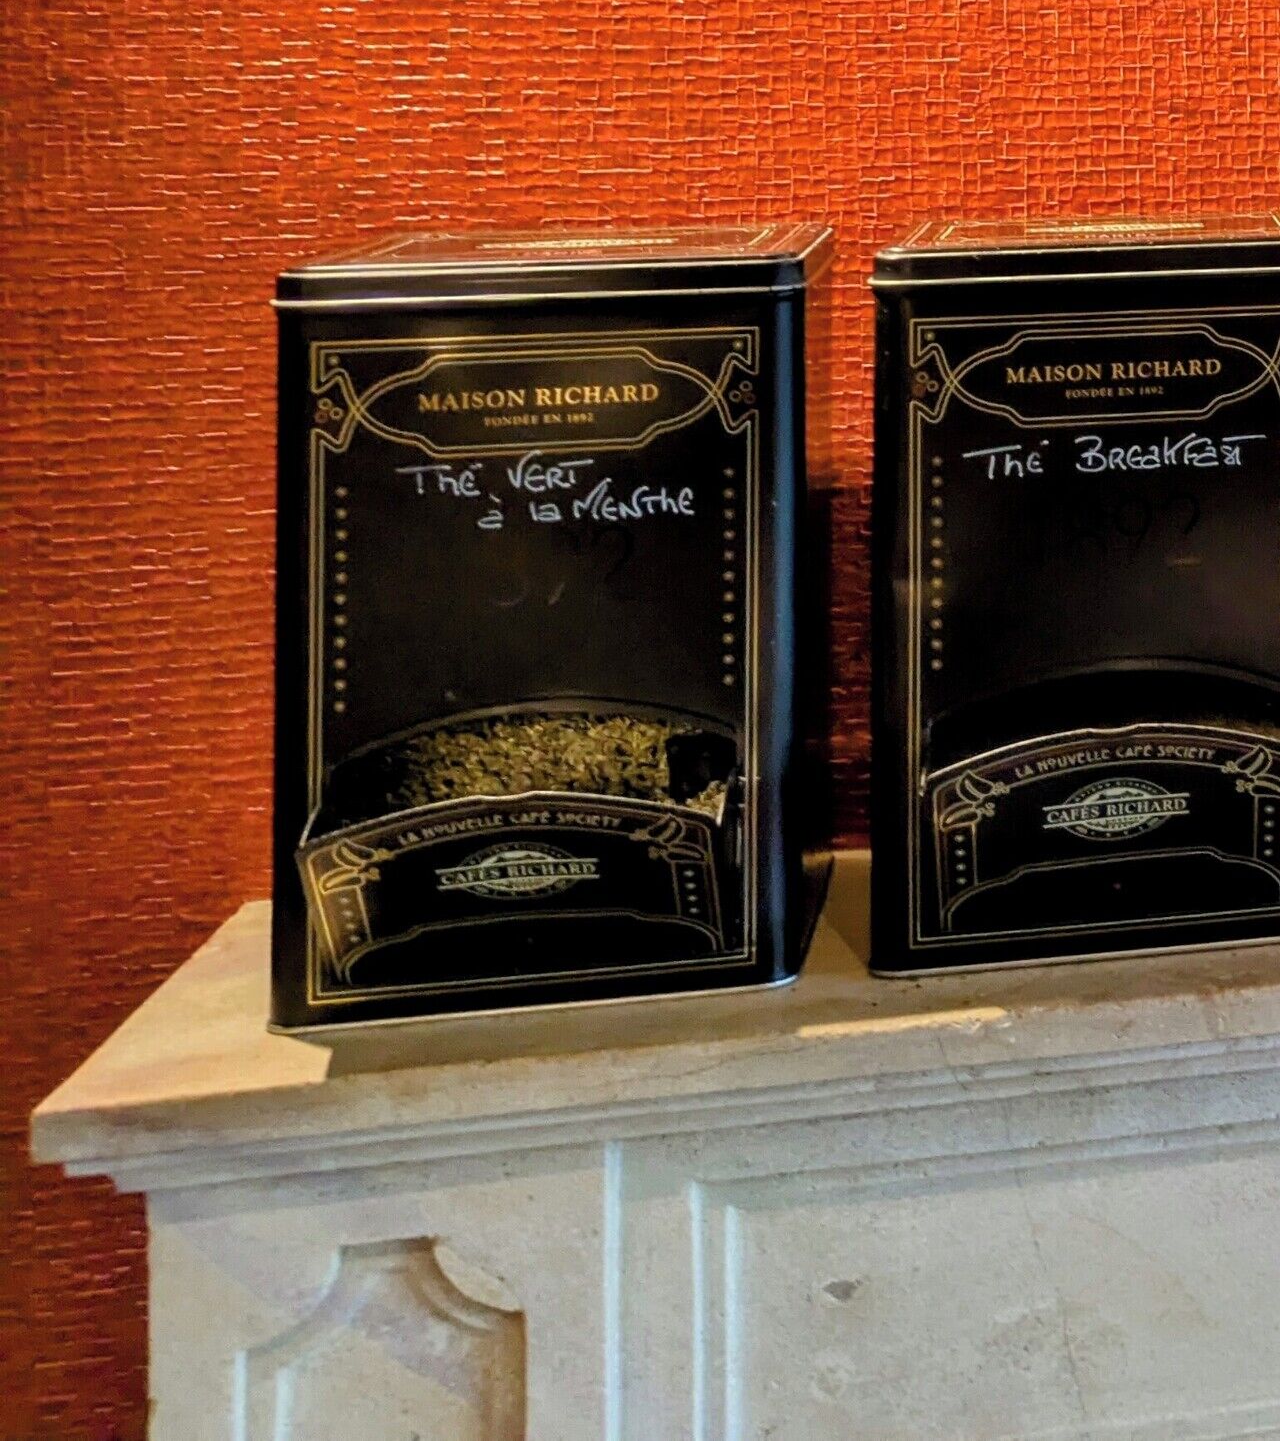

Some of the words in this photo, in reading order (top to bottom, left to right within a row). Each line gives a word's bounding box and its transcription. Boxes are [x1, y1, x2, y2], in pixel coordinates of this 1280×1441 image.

[1005, 363, 1103, 384] MAISON
[1111, 358, 1222, 379] RICHARD
[418, 388, 525, 413] MAISON
[535, 383, 660, 407] RICHARD
[1014, 766, 1035, 779] LA
[1037, 748, 1111, 774] NOUVELLE
[1105, 797, 1188, 817] RICHARD
[422, 815, 504, 840] NOUVELLE
[506, 861, 597, 878] RICHARD
